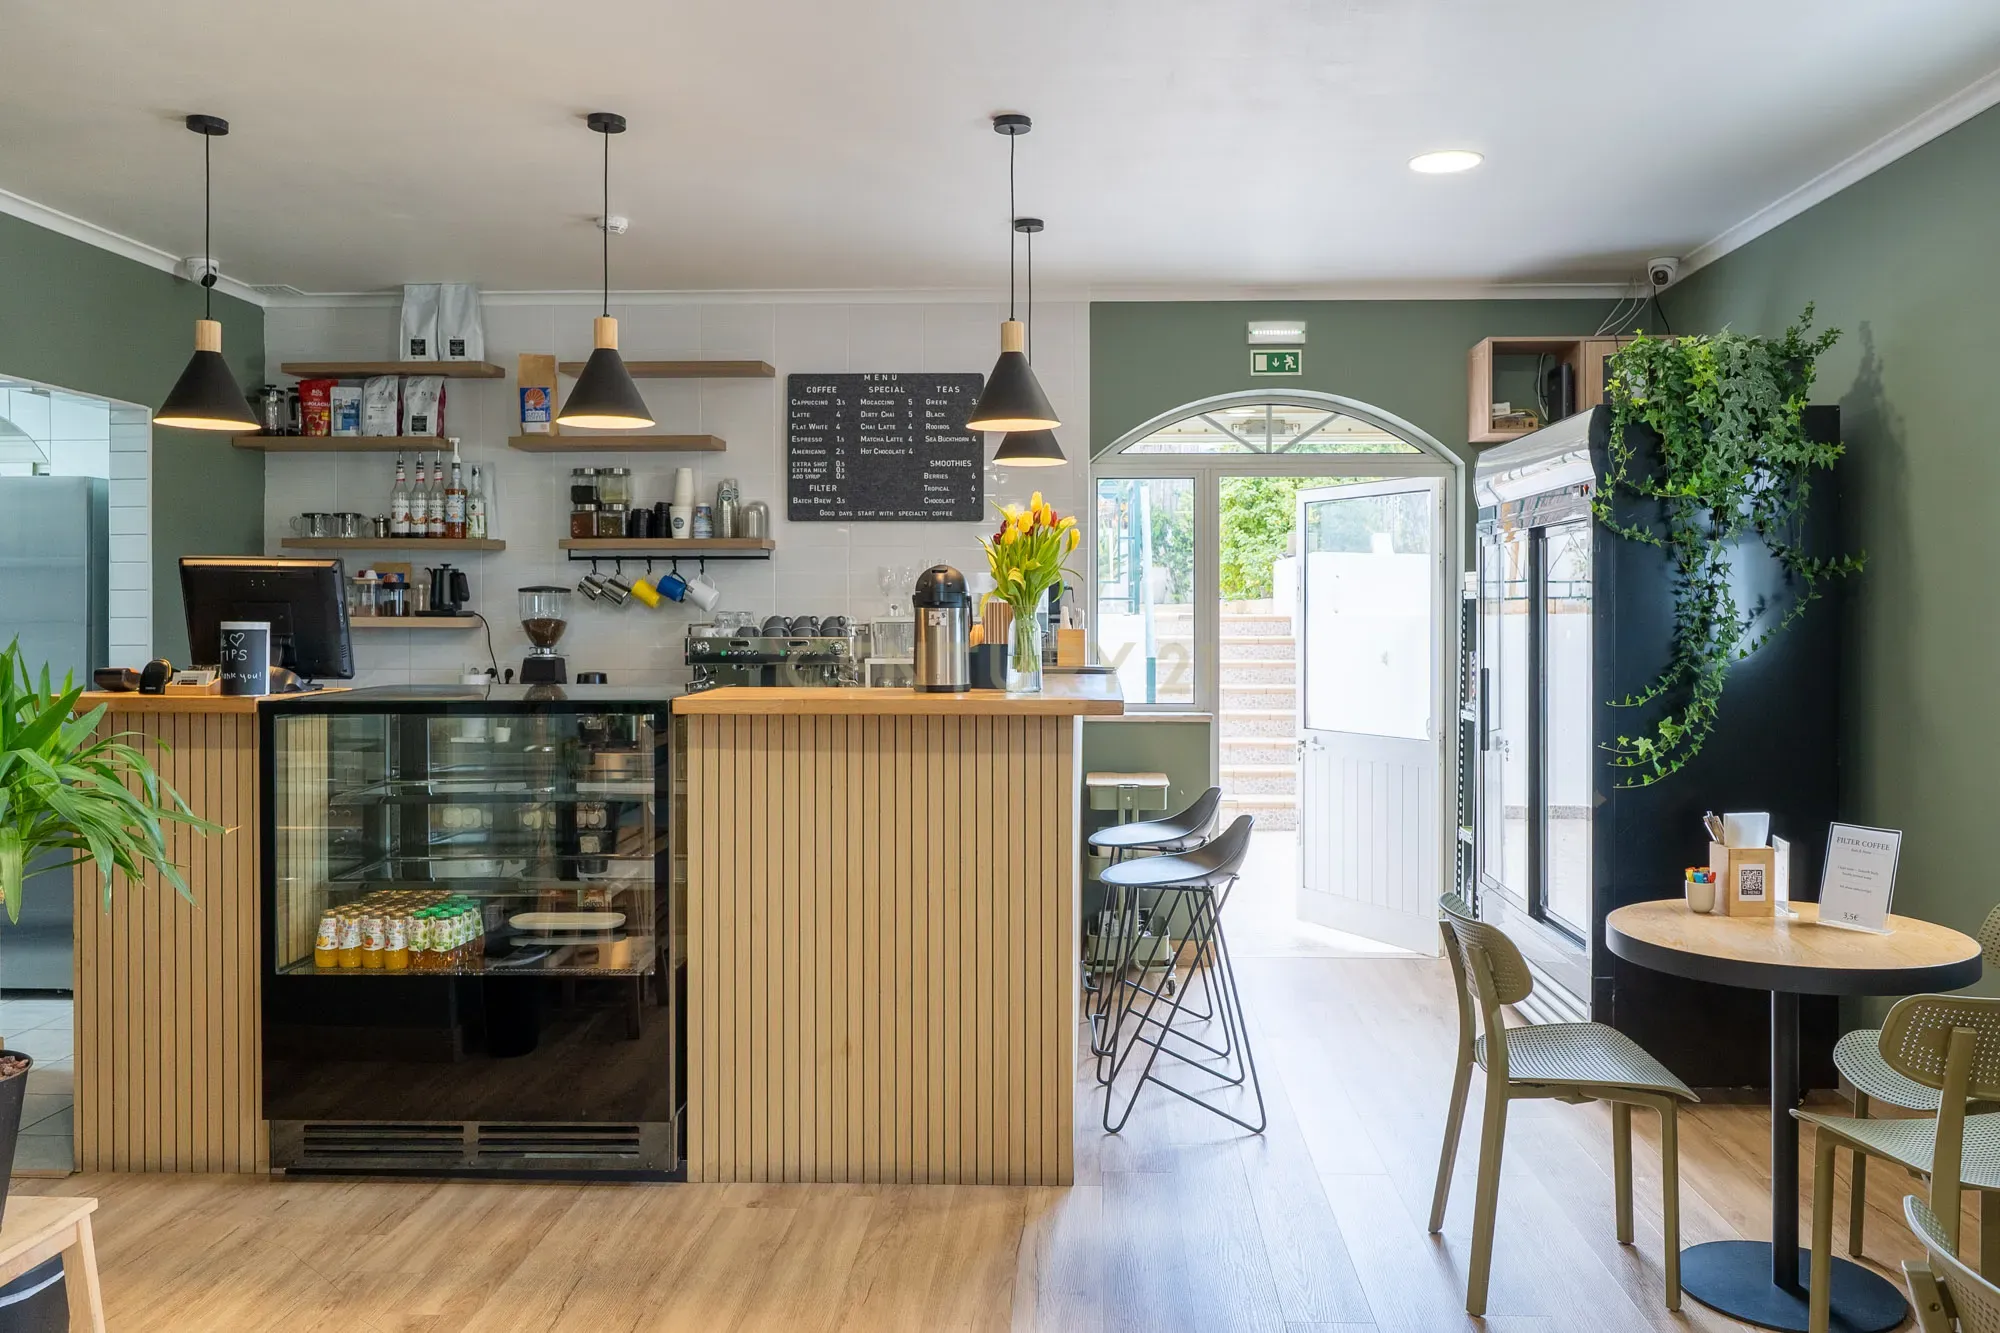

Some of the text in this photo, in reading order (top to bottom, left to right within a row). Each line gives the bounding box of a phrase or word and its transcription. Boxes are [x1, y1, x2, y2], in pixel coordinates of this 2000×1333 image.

[240, 671, 261, 682] you!
[1836, 836, 1890, 851] FILTER COFFEE
[1843, 912, 1859, 921] 3,5€
